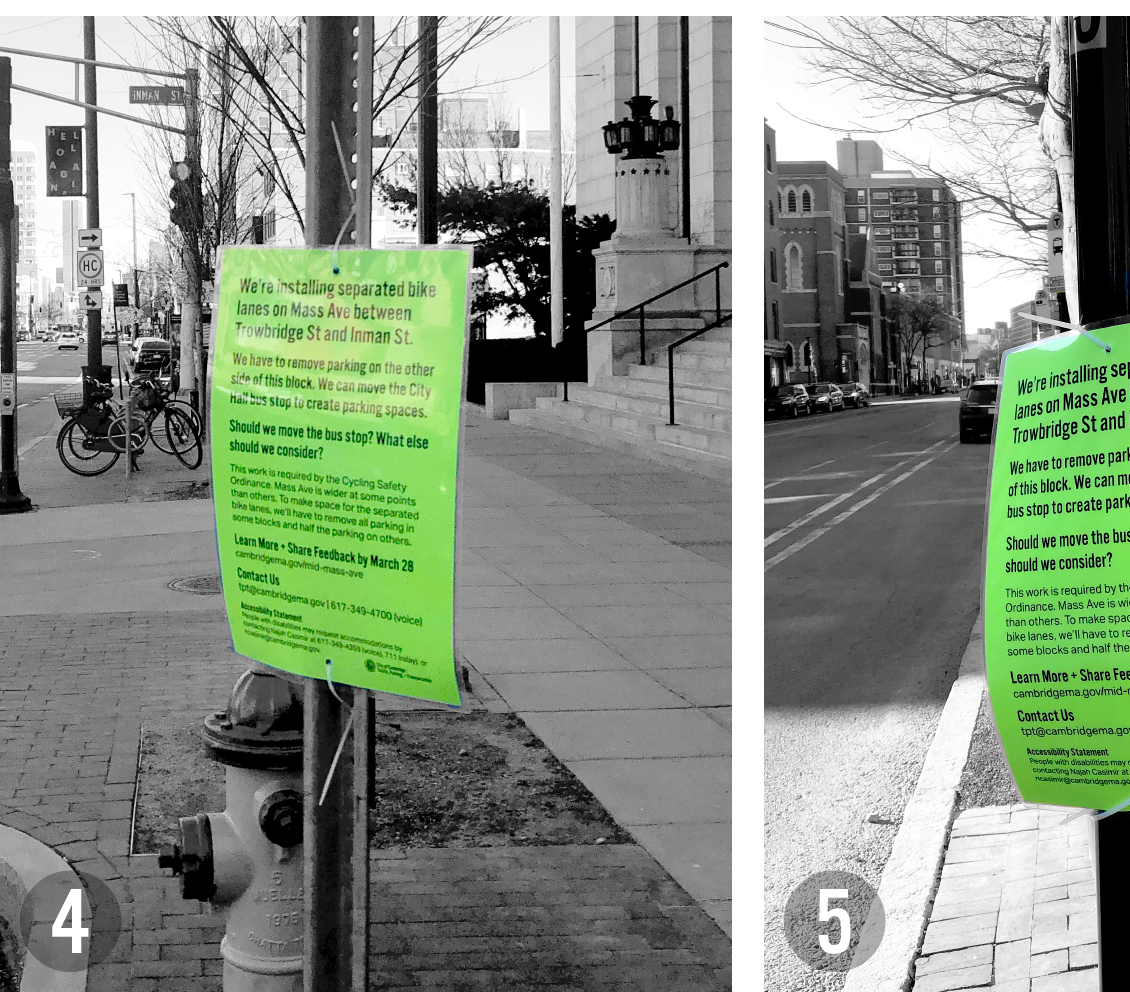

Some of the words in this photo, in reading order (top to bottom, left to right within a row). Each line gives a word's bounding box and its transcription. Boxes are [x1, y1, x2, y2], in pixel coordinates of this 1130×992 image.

[133, 89, 160, 101] INMAN
[171, 90, 180, 101] ST
[83, 260, 97, 272] HC
[240, 278, 274, 294] We're
[277, 279, 334, 299] installing
[338, 282, 404, 299] separated
[408, 281, 436, 298] bike
[237, 300, 269, 316] lanes
[273, 304, 287, 316] on
[291, 302, 324, 318] Mass
[327, 303, 350, 318] Ave
[354, 304, 412, 321] between
[235, 322, 303, 342] Trowbridge
[307, 325, 321, 340] St
[324, 326, 347, 342] and
[350, 326, 391, 343] Inman
[394, 328, 413, 345] St.
[1018, 376, 1046, 396] We're
[1050, 364, 1107, 388] installing
[1014, 402, 1043, 420] lanes
[1046, 400, 1060, 413] on
[1063, 392, 1098, 411] Mass
[1101, 387, 1126, 405] Ave
[1013, 420, 1078, 444] Trowbridge
[1081, 415, 1097, 434] St
[1100, 411, 1125, 430] and
[1010, 670, 1040, 685] Learn
[1042, 669, 1068, 683] More
[1079, 668, 1111, 682] Share
[1027, 747, 1069, 758] Accessibility
[1071, 747, 1109, 757] Statement
